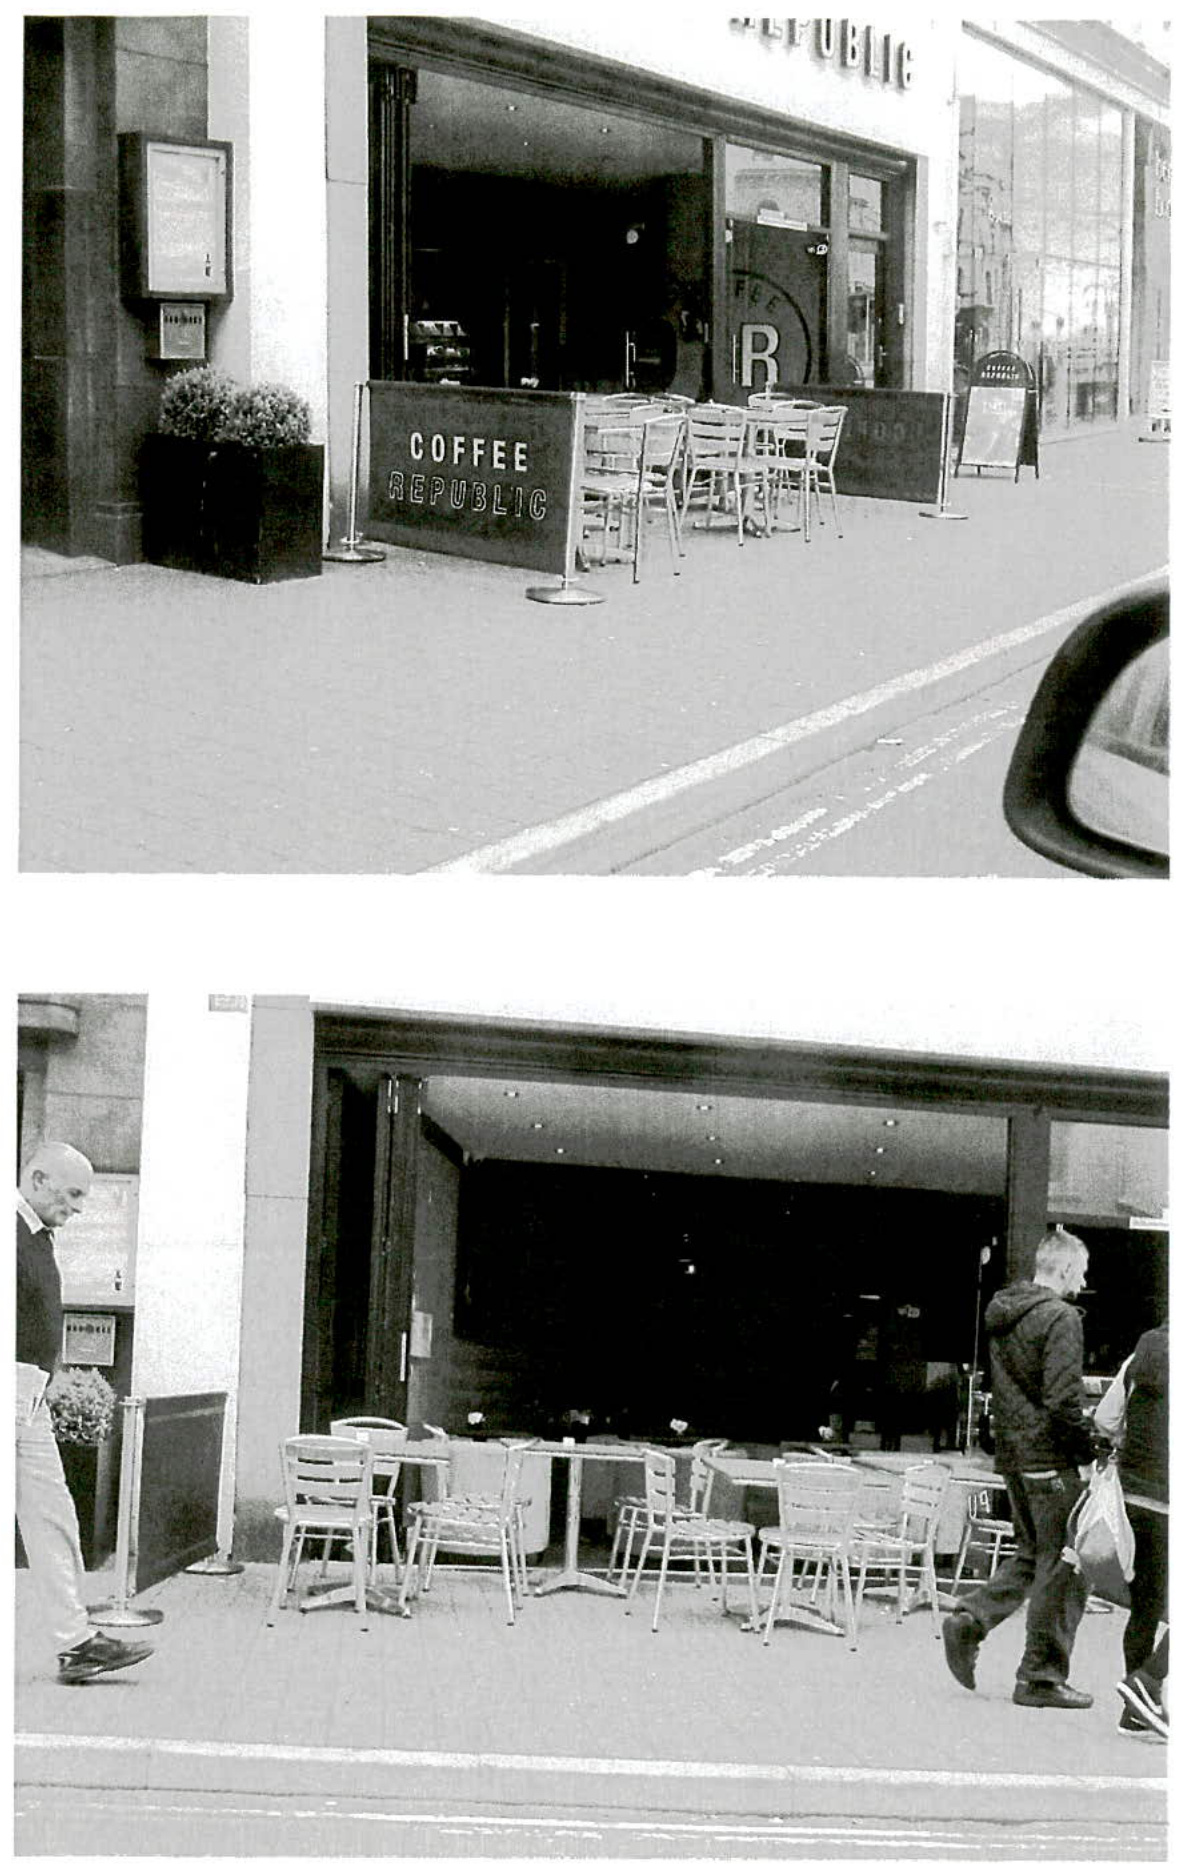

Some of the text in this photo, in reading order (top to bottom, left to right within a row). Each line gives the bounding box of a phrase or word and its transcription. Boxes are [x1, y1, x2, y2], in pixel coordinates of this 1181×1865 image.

[730, 18, 913, 89] PUBLIC
[740, 321, 780, 388] R
[410, 431, 528, 472] COFFEE
[388, 470, 548, 521] REPUBLIC
